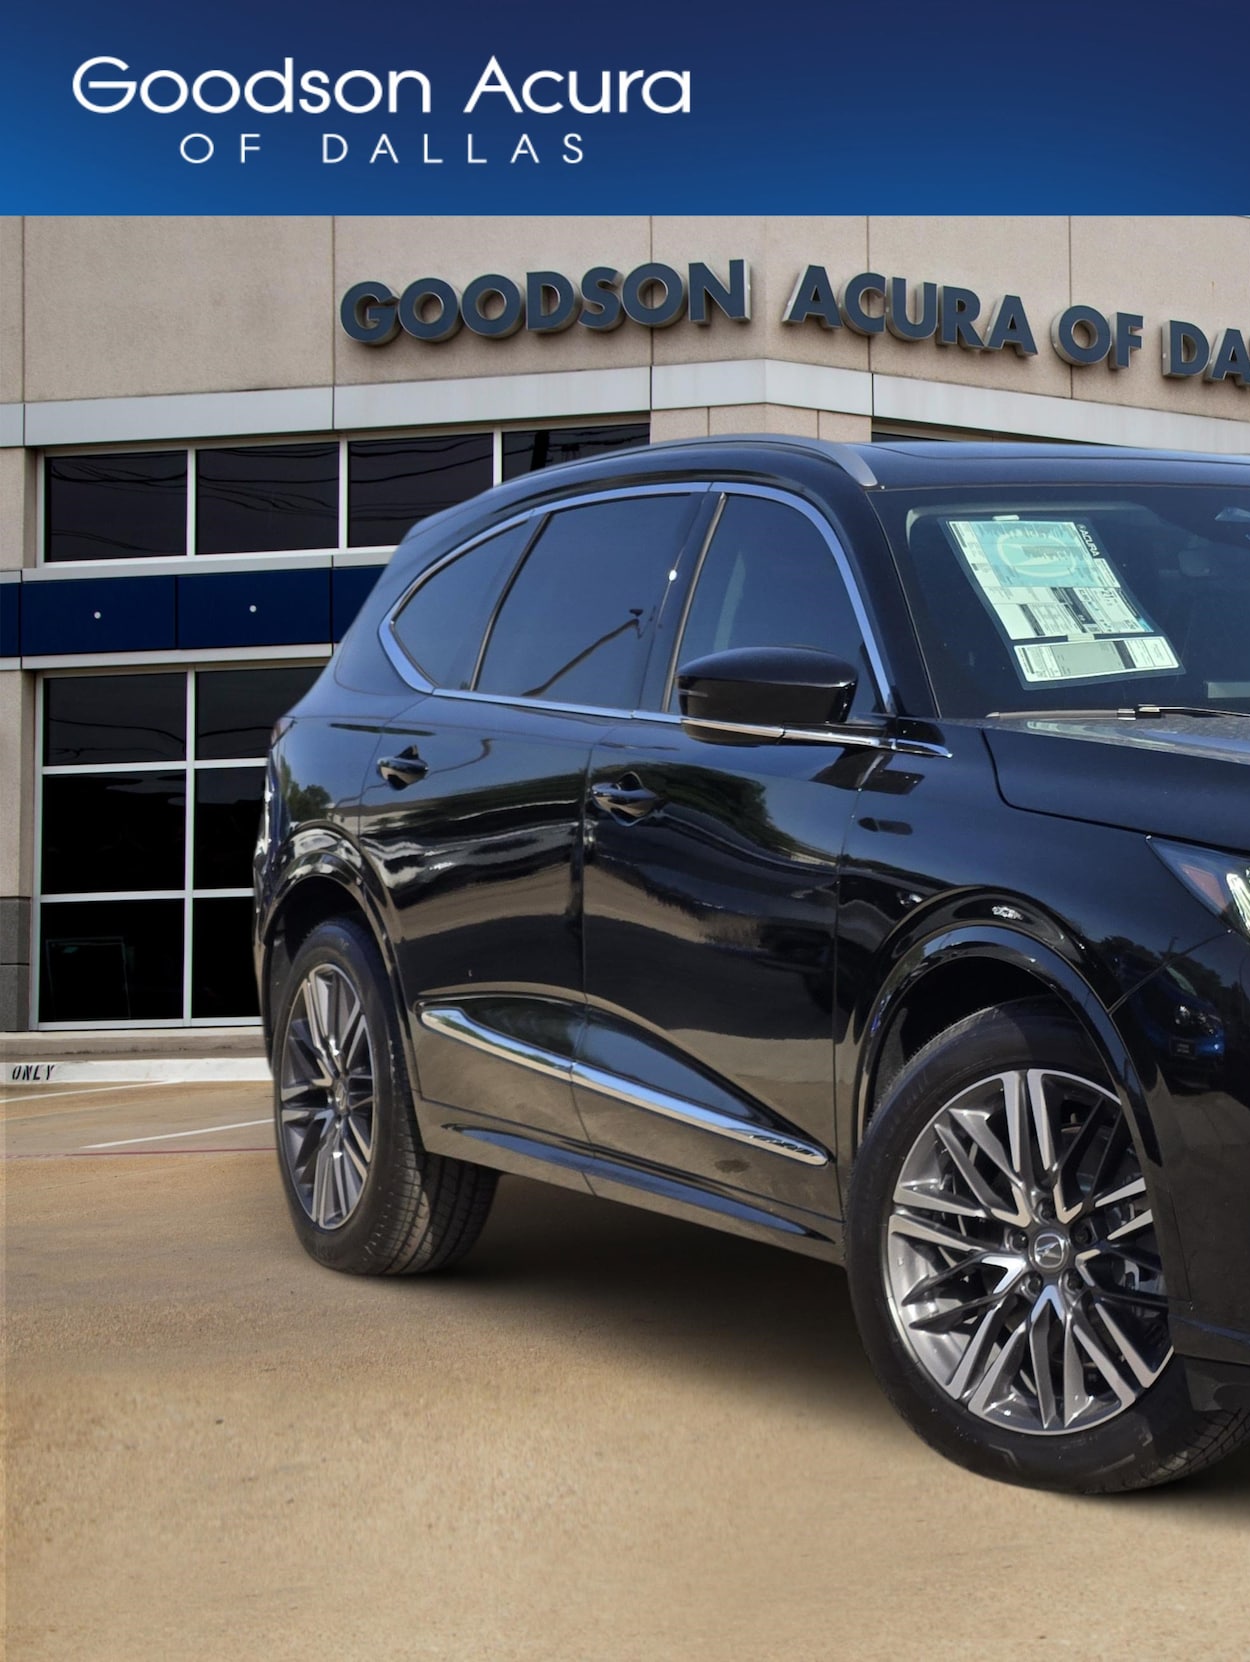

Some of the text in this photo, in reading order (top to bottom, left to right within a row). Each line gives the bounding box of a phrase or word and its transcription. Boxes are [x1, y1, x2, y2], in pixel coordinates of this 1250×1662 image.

[340, 258, 751, 345] GOODSON
[782, 264, 1038, 357] ACURA
[1051, 304, 1144, 370] OF
[12, 1064, 55, 1081] ONLY
